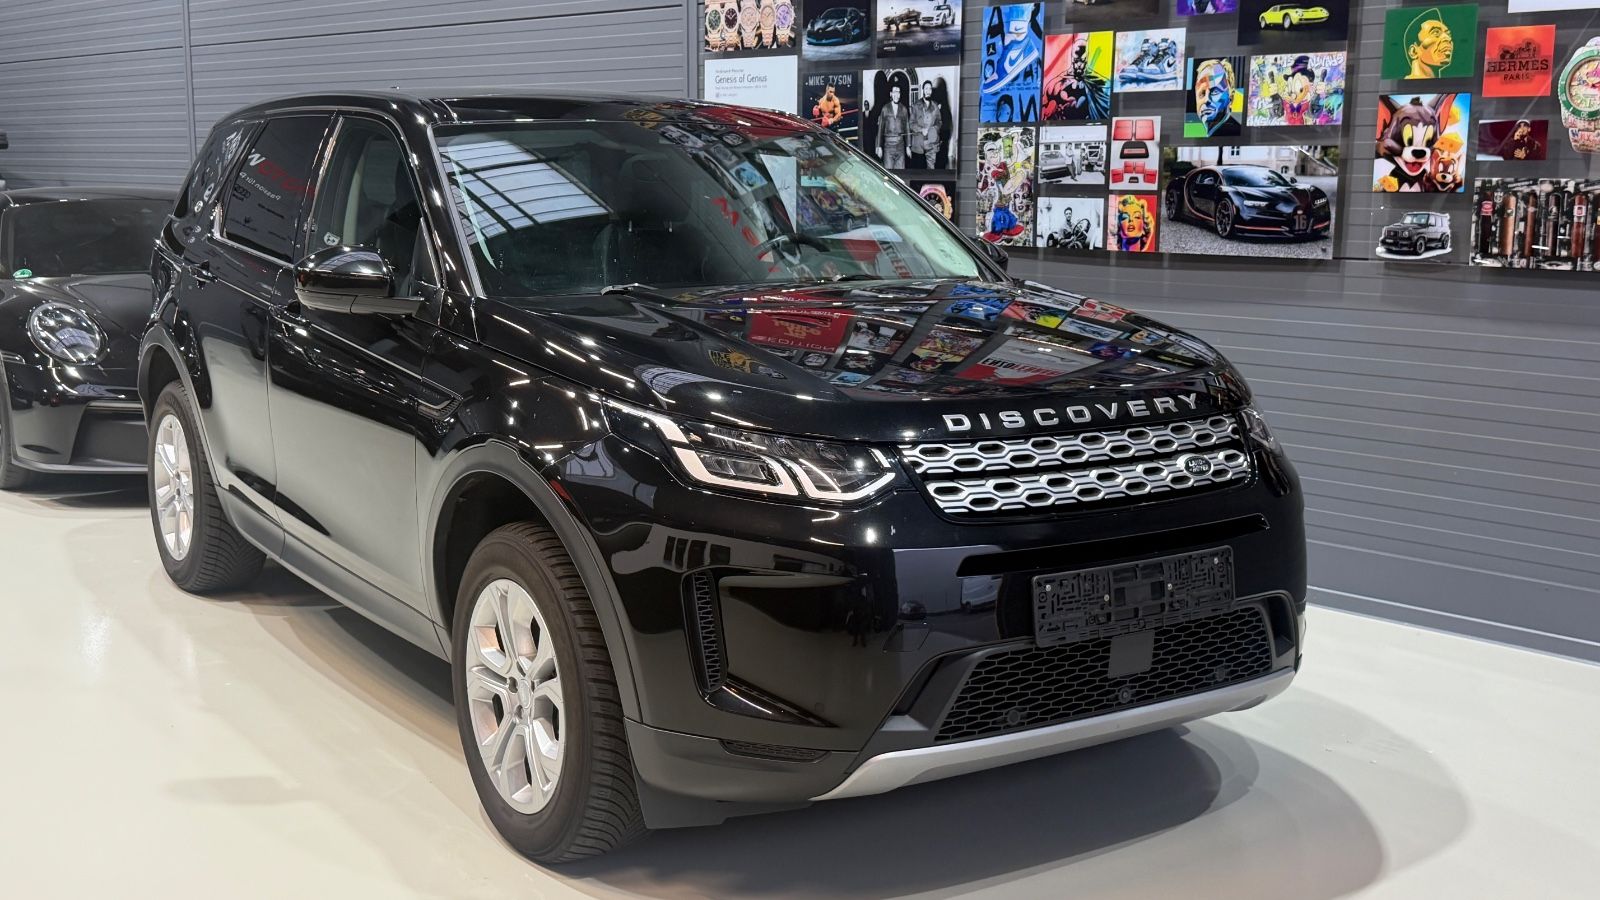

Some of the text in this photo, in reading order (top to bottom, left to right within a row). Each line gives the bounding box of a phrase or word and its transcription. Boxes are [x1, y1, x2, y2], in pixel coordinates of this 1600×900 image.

[715, 73, 767, 83] Genesis of Genius
[808, 74, 852, 86] MIKE TYSON
[1503, 73, 1531, 81] PARIS
[1294, 215, 1306, 230] 16
[941, 393, 1197, 432] DISCOVERY
